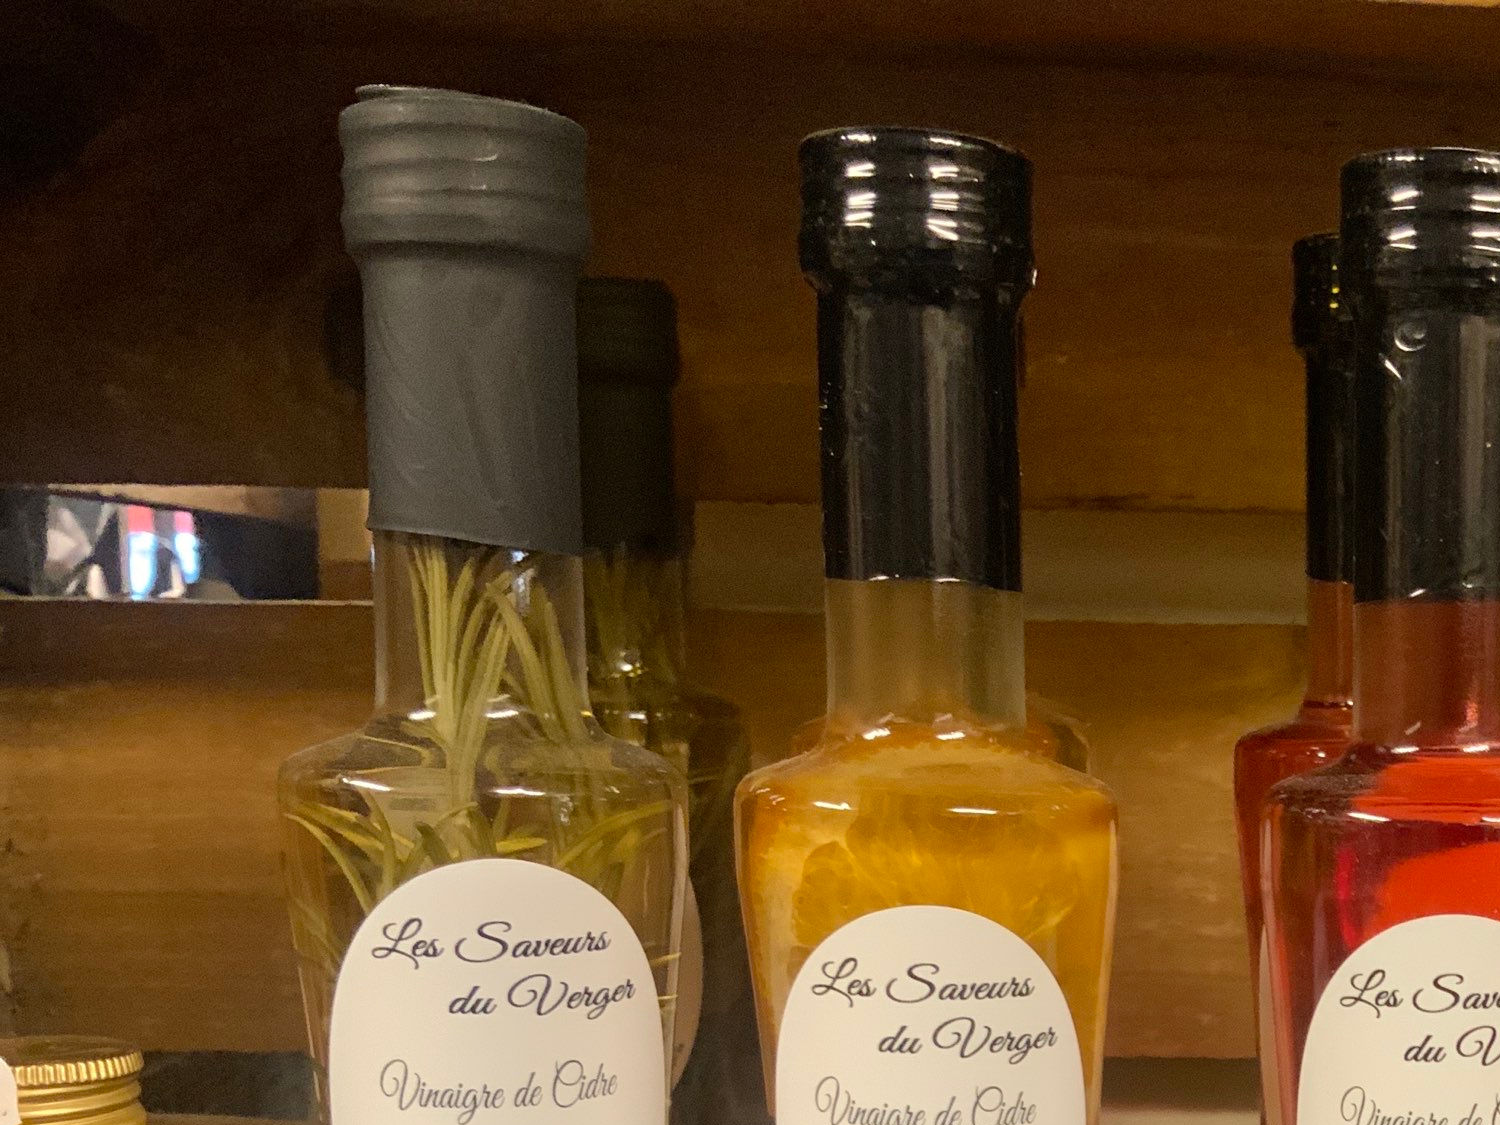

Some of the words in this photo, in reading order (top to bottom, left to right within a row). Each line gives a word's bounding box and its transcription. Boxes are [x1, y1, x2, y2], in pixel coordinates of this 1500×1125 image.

[372, 917, 444, 969] Les
[455, 921, 611, 963] Saveurs
[448, 985, 496, 1015] du
[507, 974, 635, 1019] Verger
[810, 956, 877, 1007] Les
[886, 962, 1035, 1004] Saveurs
[1340, 969, 1402, 1019] Les
[878, 1025, 922, 1056] du
[932, 1016, 1058, 1065] Verger
[1404, 1034, 1445, 1063] du
[380, 1059, 504, 1125] Vinaigre
[514, 1072, 542, 1106] de
[551, 1060, 617, 1109] Cidre
